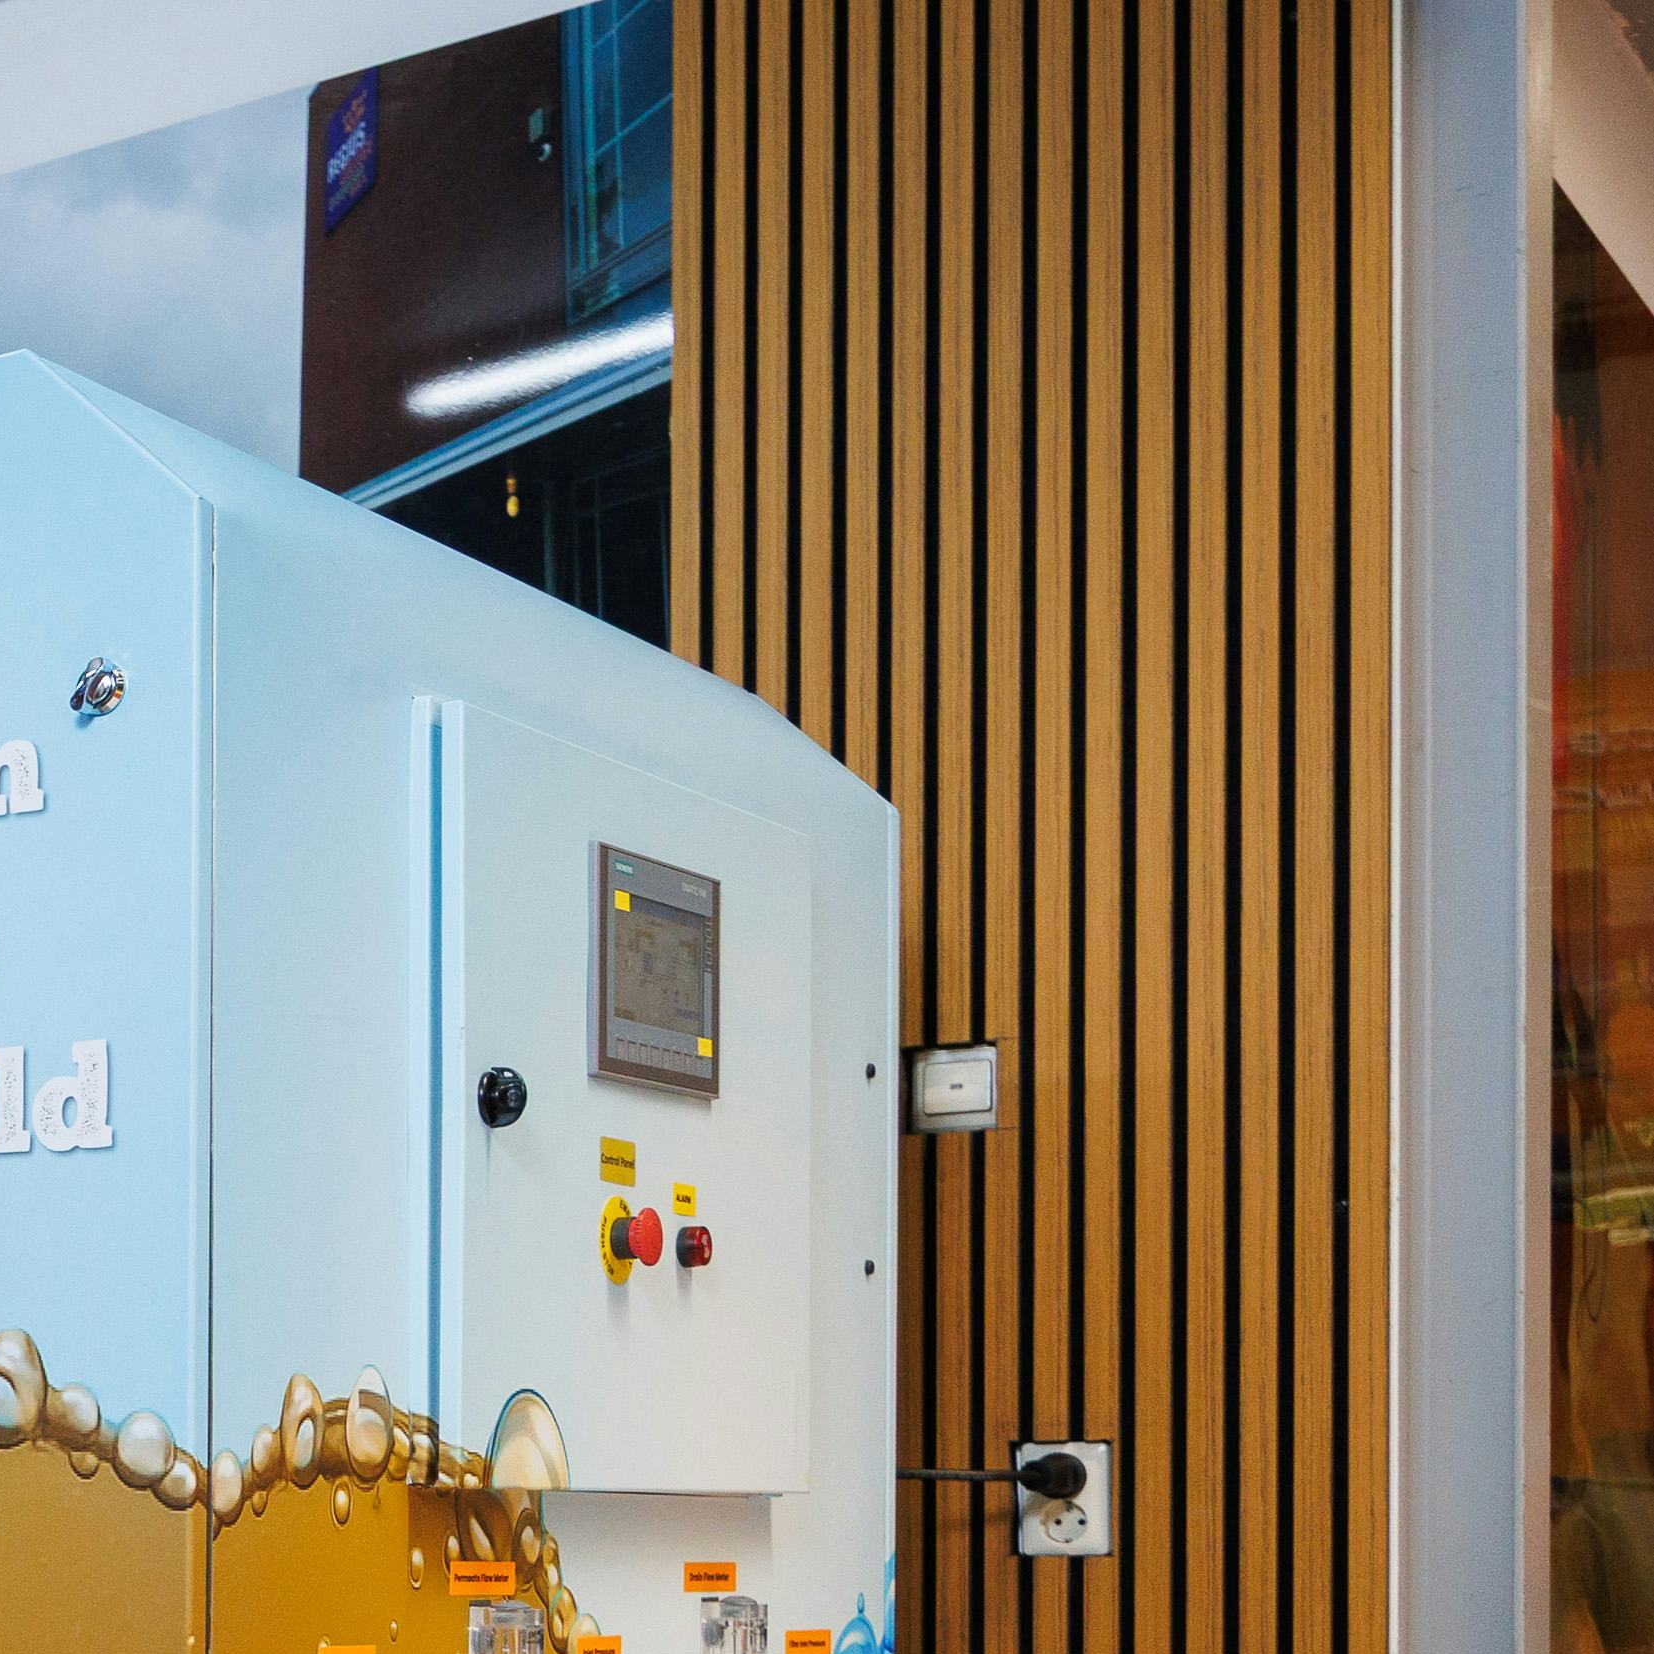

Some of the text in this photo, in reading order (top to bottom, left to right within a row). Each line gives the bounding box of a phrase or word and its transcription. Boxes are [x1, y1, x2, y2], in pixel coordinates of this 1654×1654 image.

[600, 1153, 635, 1169] Control Panel
[676, 1193, 692, 1204] ALARM
